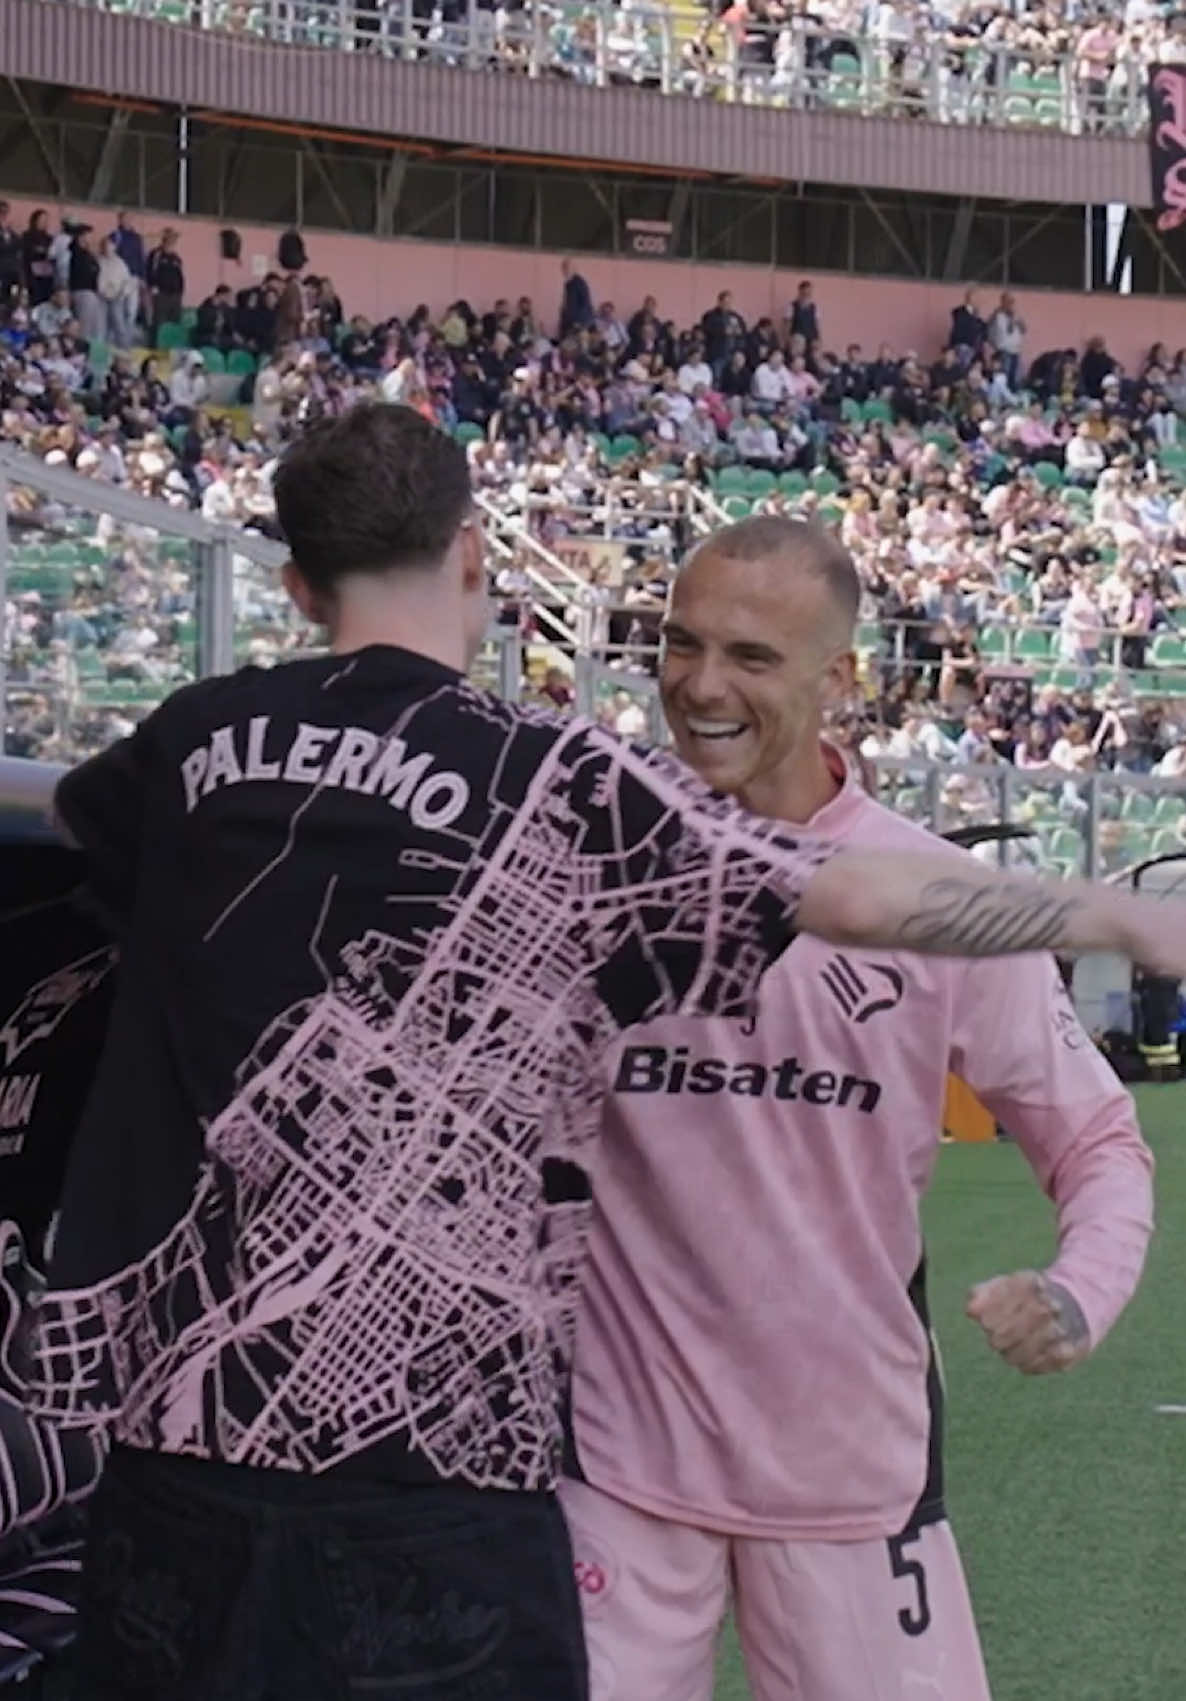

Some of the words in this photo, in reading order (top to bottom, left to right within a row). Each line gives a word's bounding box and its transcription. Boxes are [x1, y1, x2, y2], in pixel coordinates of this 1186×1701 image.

[181, 715, 469, 829] PALERMO
[613, 1046, 882, 1114] Bisaten
[886, 1535, 931, 1636] 5
